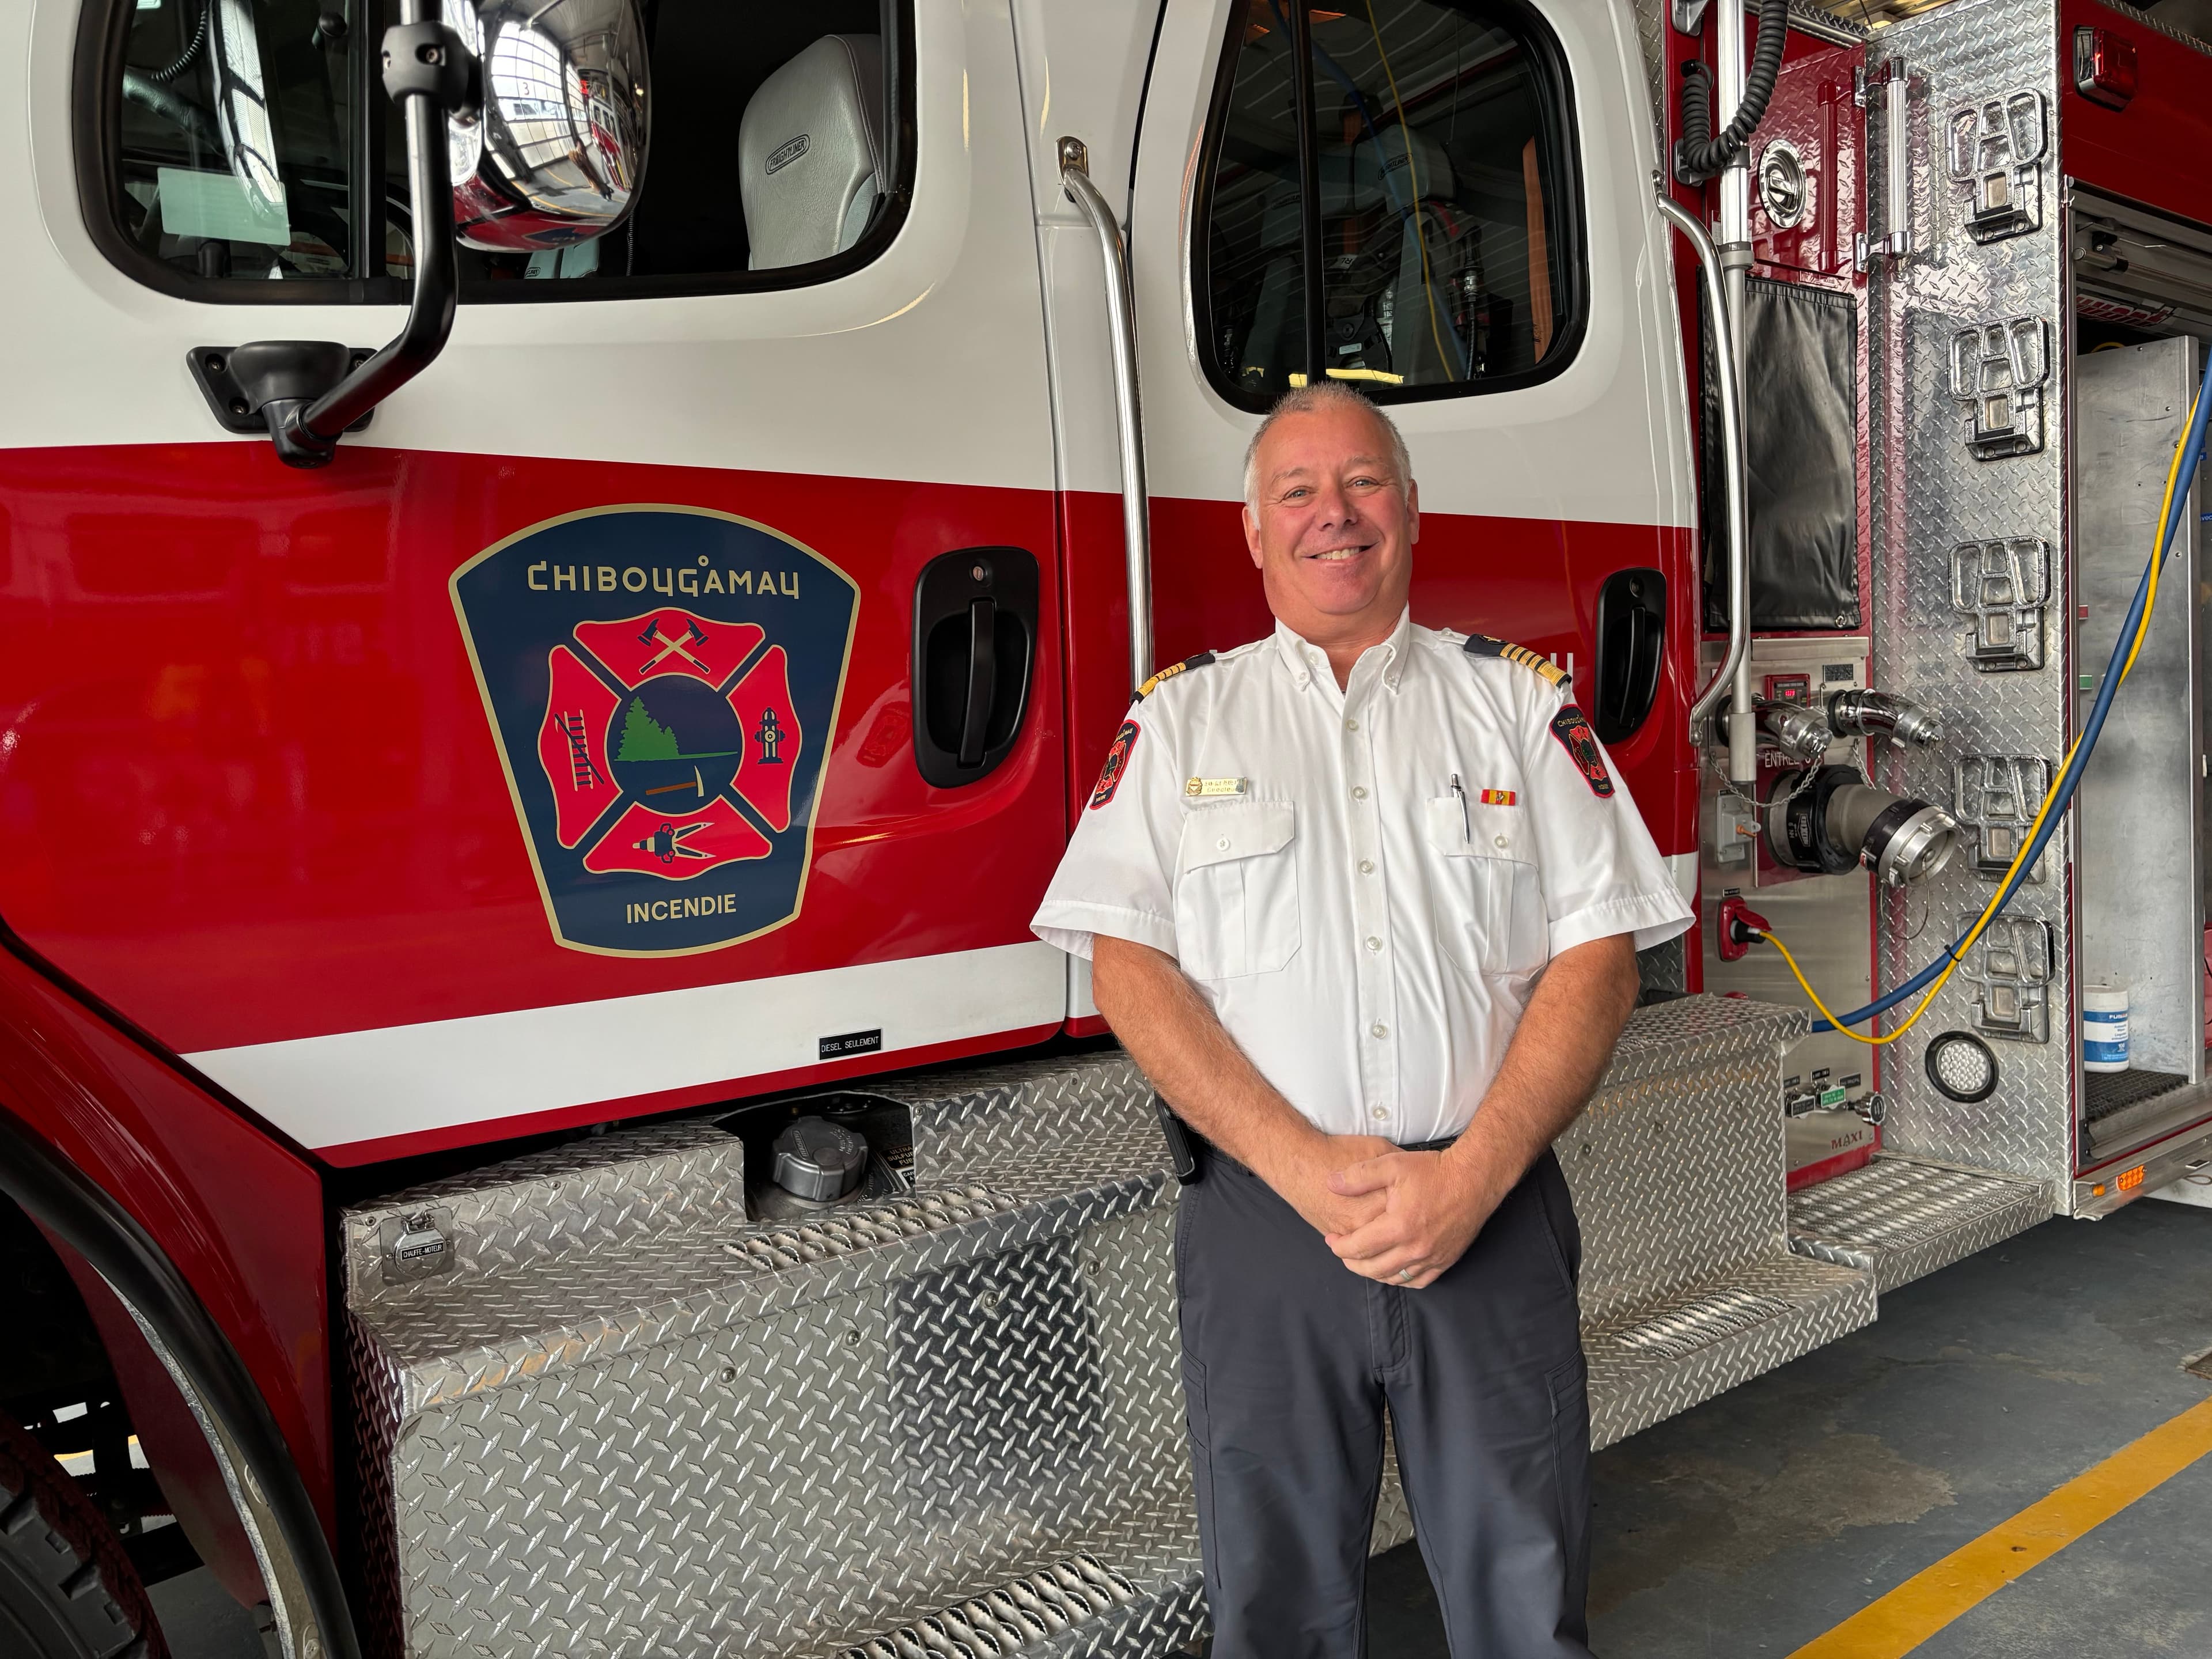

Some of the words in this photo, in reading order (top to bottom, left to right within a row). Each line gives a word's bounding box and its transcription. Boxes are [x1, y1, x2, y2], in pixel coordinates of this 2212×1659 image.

[770, 139, 805, 169] FREIGHTLINER
[527, 555, 800, 600] CHIBOUGAMAU
[626, 894, 737, 925] INCENDIE
[821, 1043, 842, 1053] DIESEL
[844, 1036, 880, 1049] SEULEMENT
[1831, 1130, 1862, 1150] MAXI
[403, 1244, 442, 1258] CHAUFFE-MOTEUR
